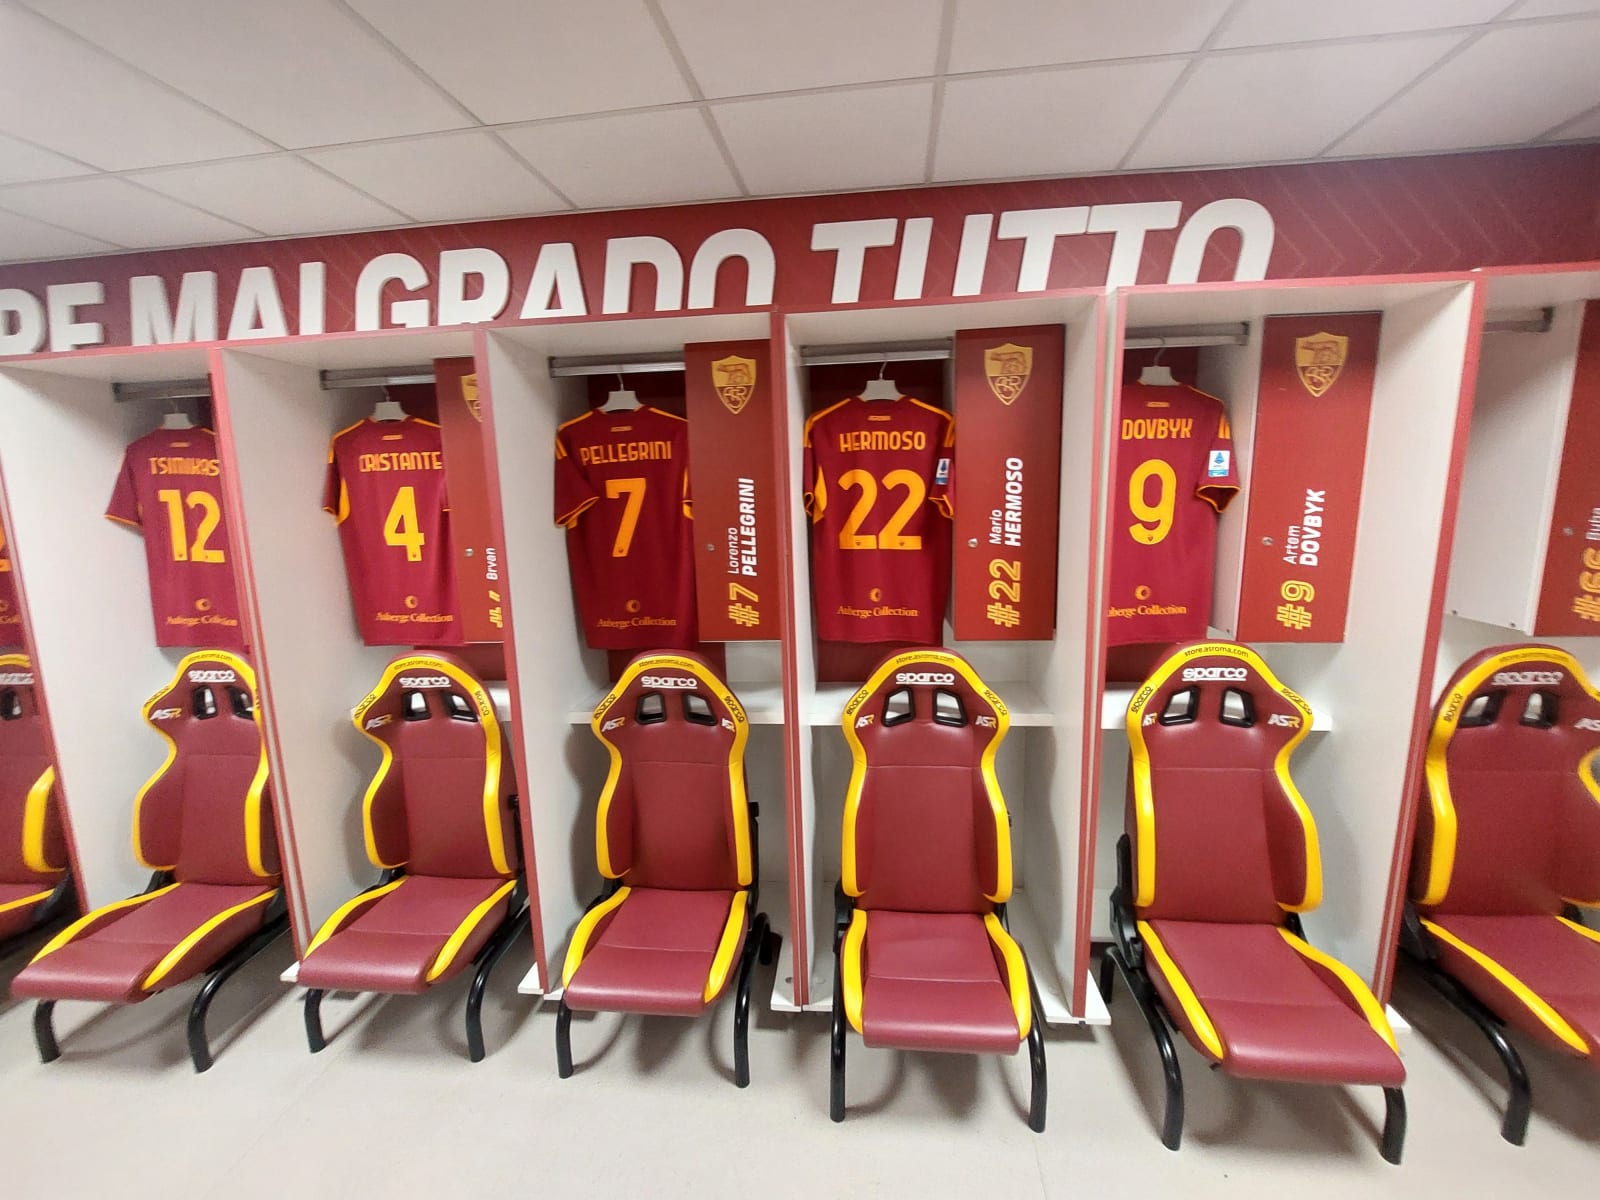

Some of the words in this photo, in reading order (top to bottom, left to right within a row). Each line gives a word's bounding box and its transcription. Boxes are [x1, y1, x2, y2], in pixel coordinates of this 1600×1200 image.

[131, 227, 776, 346] MALGRADO
[811, 198, 1275, 304] TUTTO
[840, 431, 926, 452] HERMOSO
[1121, 418, 1193, 440] DOVBYK
[359, 451, 443, 472] CRISTANTE
[580, 441, 672, 466] PELLEGRINI
[605, 478, 647, 557] 7
[838, 469, 926, 550] 22
[1005, 457, 1024, 547] HERMOSO
[1129, 459, 1177, 545] 9
[158, 489, 225, 563] 12
[384, 486, 425, 562] 4
[738, 478, 758, 576] PELLEGRINI
[989, 509, 1003, 545] Mario
[1300, 488, 1326, 567] DOVBYK
[728, 583, 760, 627] #7
[987, 558, 1022, 628] #22
[1276, 579, 1316, 630] #9
[1184, 646, 1249, 658] store.asroma.com
[399, 676, 451, 688] sparco
[641, 675, 698, 689] sparco
[896, 672, 955, 686] sparco
[1182, 667, 1248, 682] sparco
[975, 714, 997, 729] ASR
[1267, 713, 1301, 728] ASR
